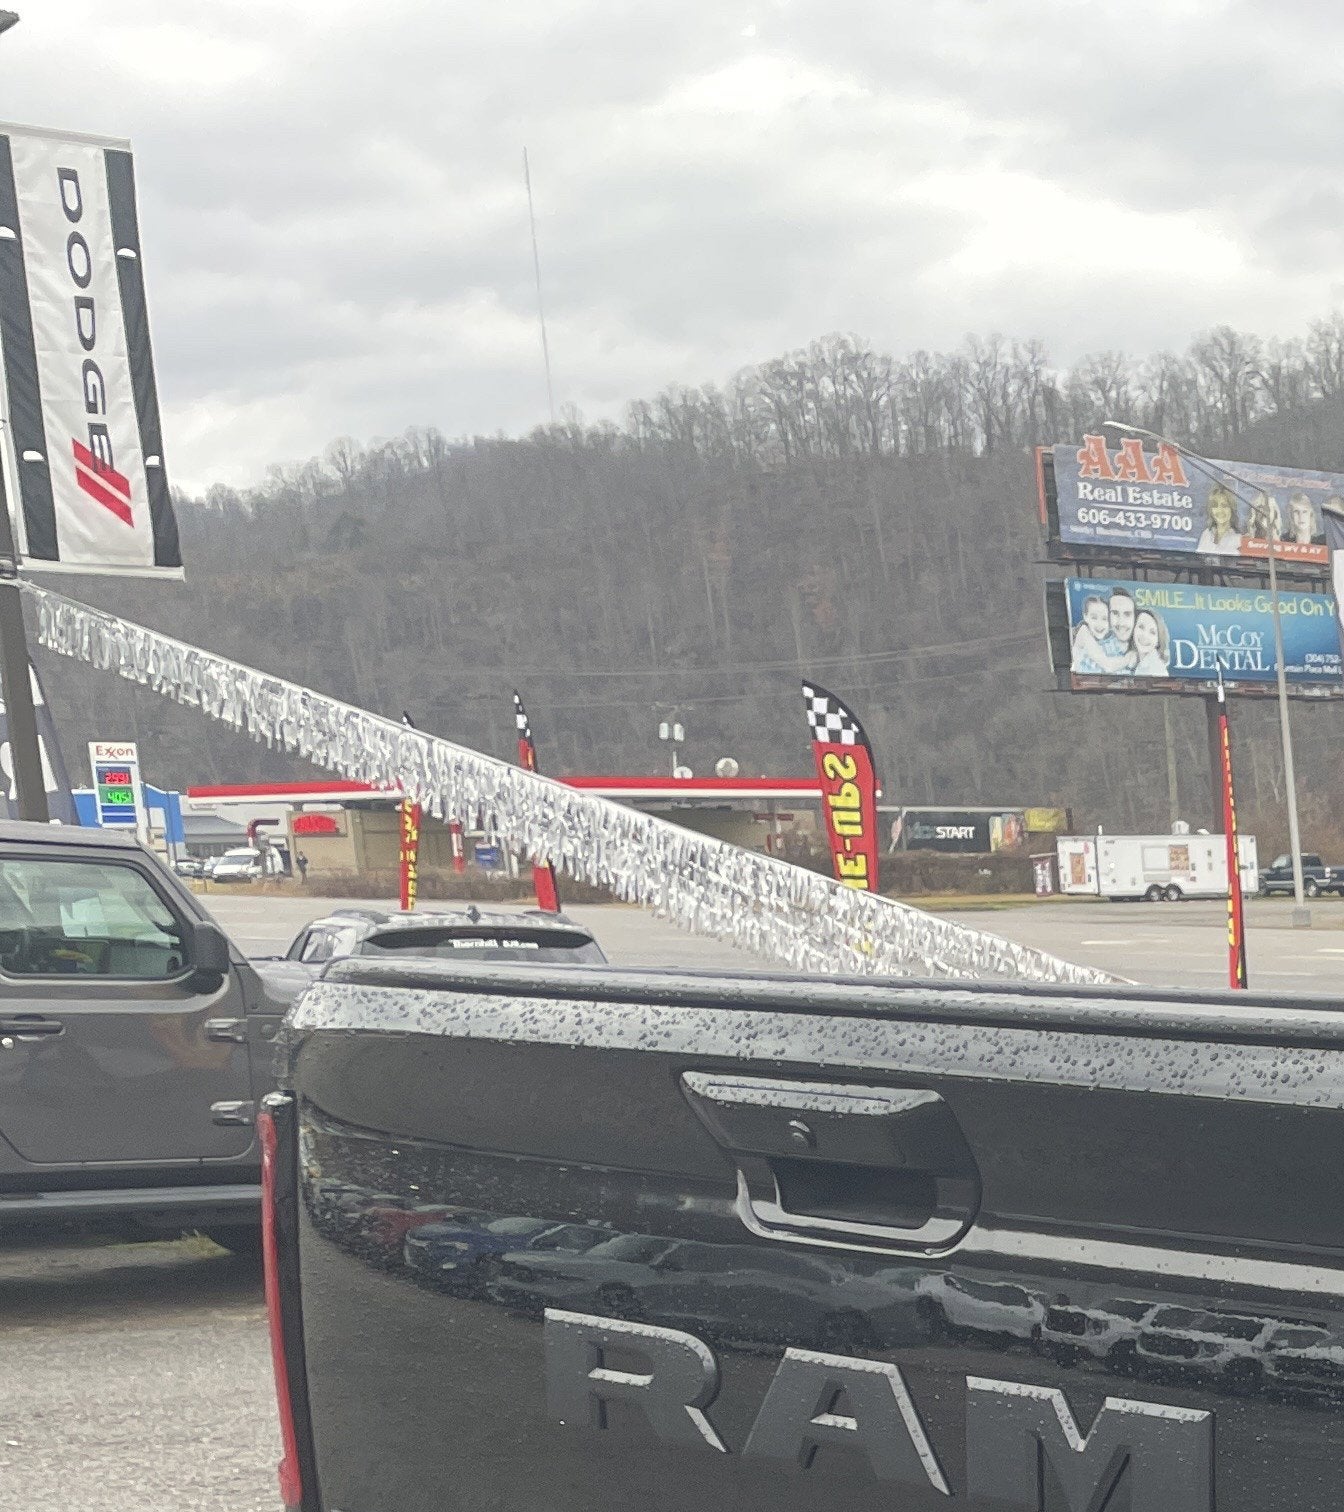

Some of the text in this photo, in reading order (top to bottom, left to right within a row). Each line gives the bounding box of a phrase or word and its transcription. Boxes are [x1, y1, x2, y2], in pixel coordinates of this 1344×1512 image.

[56, 167, 115, 473] DODGE
[1076, 433, 1190, 488] AAA
[1077, 482, 1193, 510] Real Estate
[1077, 507, 1193, 532] 606-433-9700
[1208, 594, 1252, 612] Looks
[1300, 598, 1324, 616] On
[95, 745, 135, 760] Exxon
[935, 826, 976, 840] START
